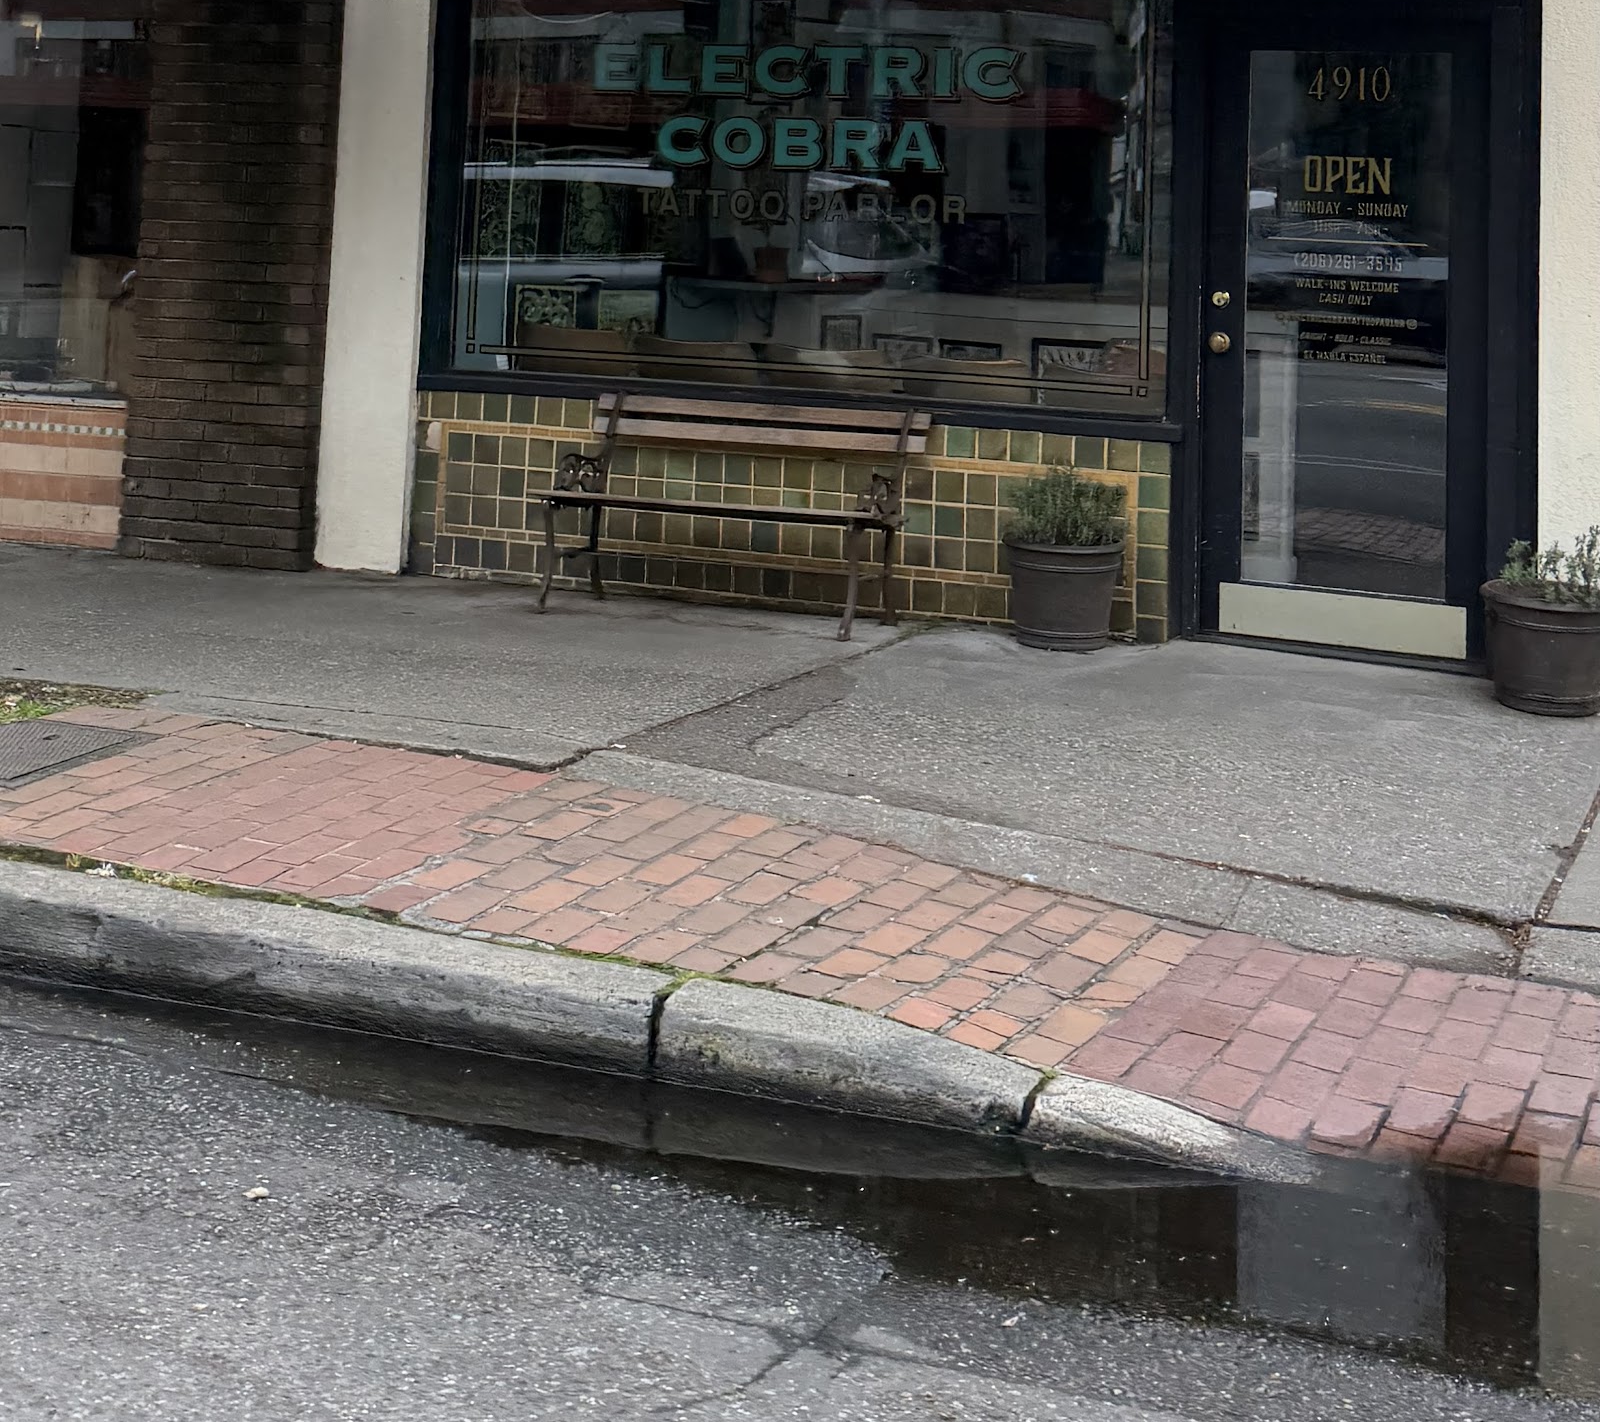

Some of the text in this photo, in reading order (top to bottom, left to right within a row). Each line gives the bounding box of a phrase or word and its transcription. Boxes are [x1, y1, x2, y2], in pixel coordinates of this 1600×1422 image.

[593, 43, 1026, 105] ELECTRIC
[1308, 65, 1391, 102] 4910
[656, 115, 946, 173] COBRA
[1304, 154, 1393, 196] OPEN
[637, 187, 787, 220] TATTOO
[1358, 202, 1409, 218] SUNDAY
[1318, 292, 1374, 306] CASH ONLY
[1349, 280, 1400, 294] WELCOME
